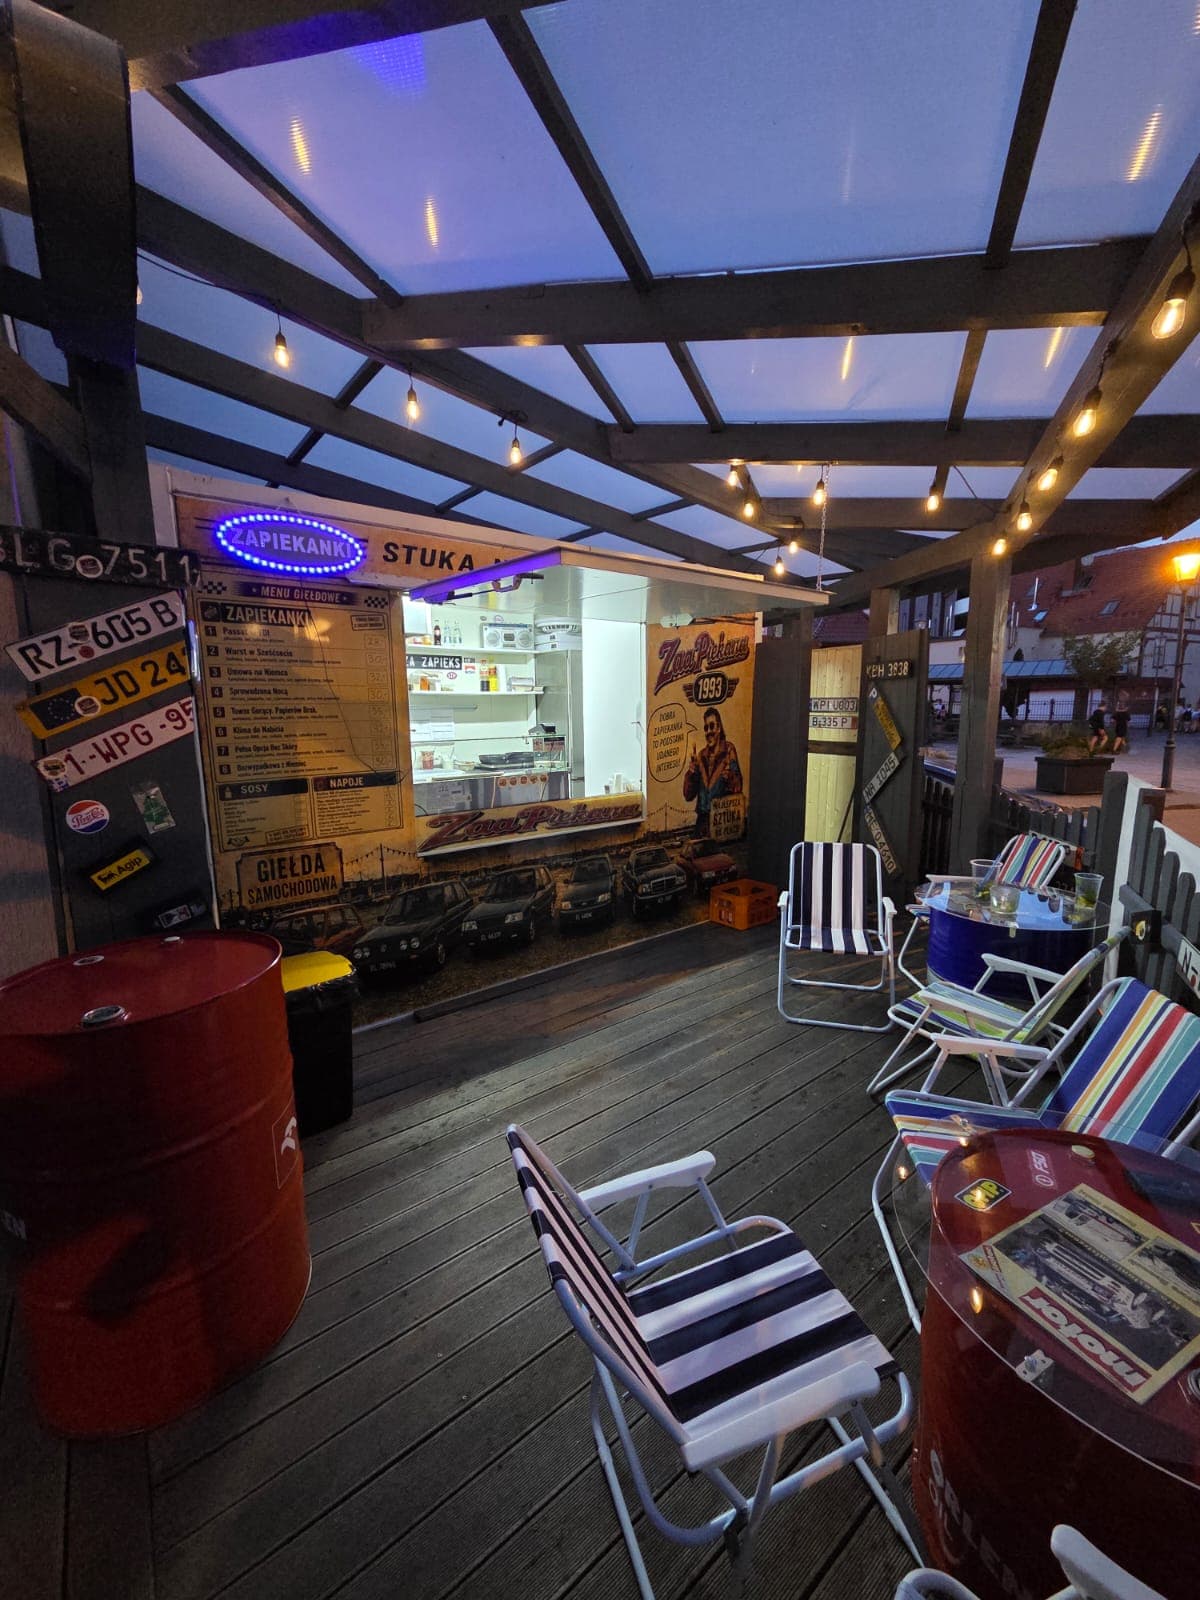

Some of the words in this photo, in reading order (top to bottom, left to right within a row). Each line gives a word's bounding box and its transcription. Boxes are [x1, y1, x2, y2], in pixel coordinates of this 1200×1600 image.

[231, 527, 352, 558] ZAPIEKANKI
[382, 541, 475, 571] STUKA
[261, 586, 290, 598] MENU
[294, 588, 341, 603] GIEŁDOWE
[225, 605, 310, 627] ZAPIEKANKI
[421, 656, 461, 670] ZAPIEKS
[94, 669, 141, 706] JD
[697, 676, 723, 700] 1993
[240, 783, 269, 794] SOSY
[329, 776, 364, 788] NAPOJE
[713, 809, 741, 826] SZTUKA
[116, 855, 143, 875] Agip
[256, 852, 326, 883] GIEŁDA
[247, 875, 338, 905] SAMOCHODOWA
[1021, 1295, 1148, 1388] motor
